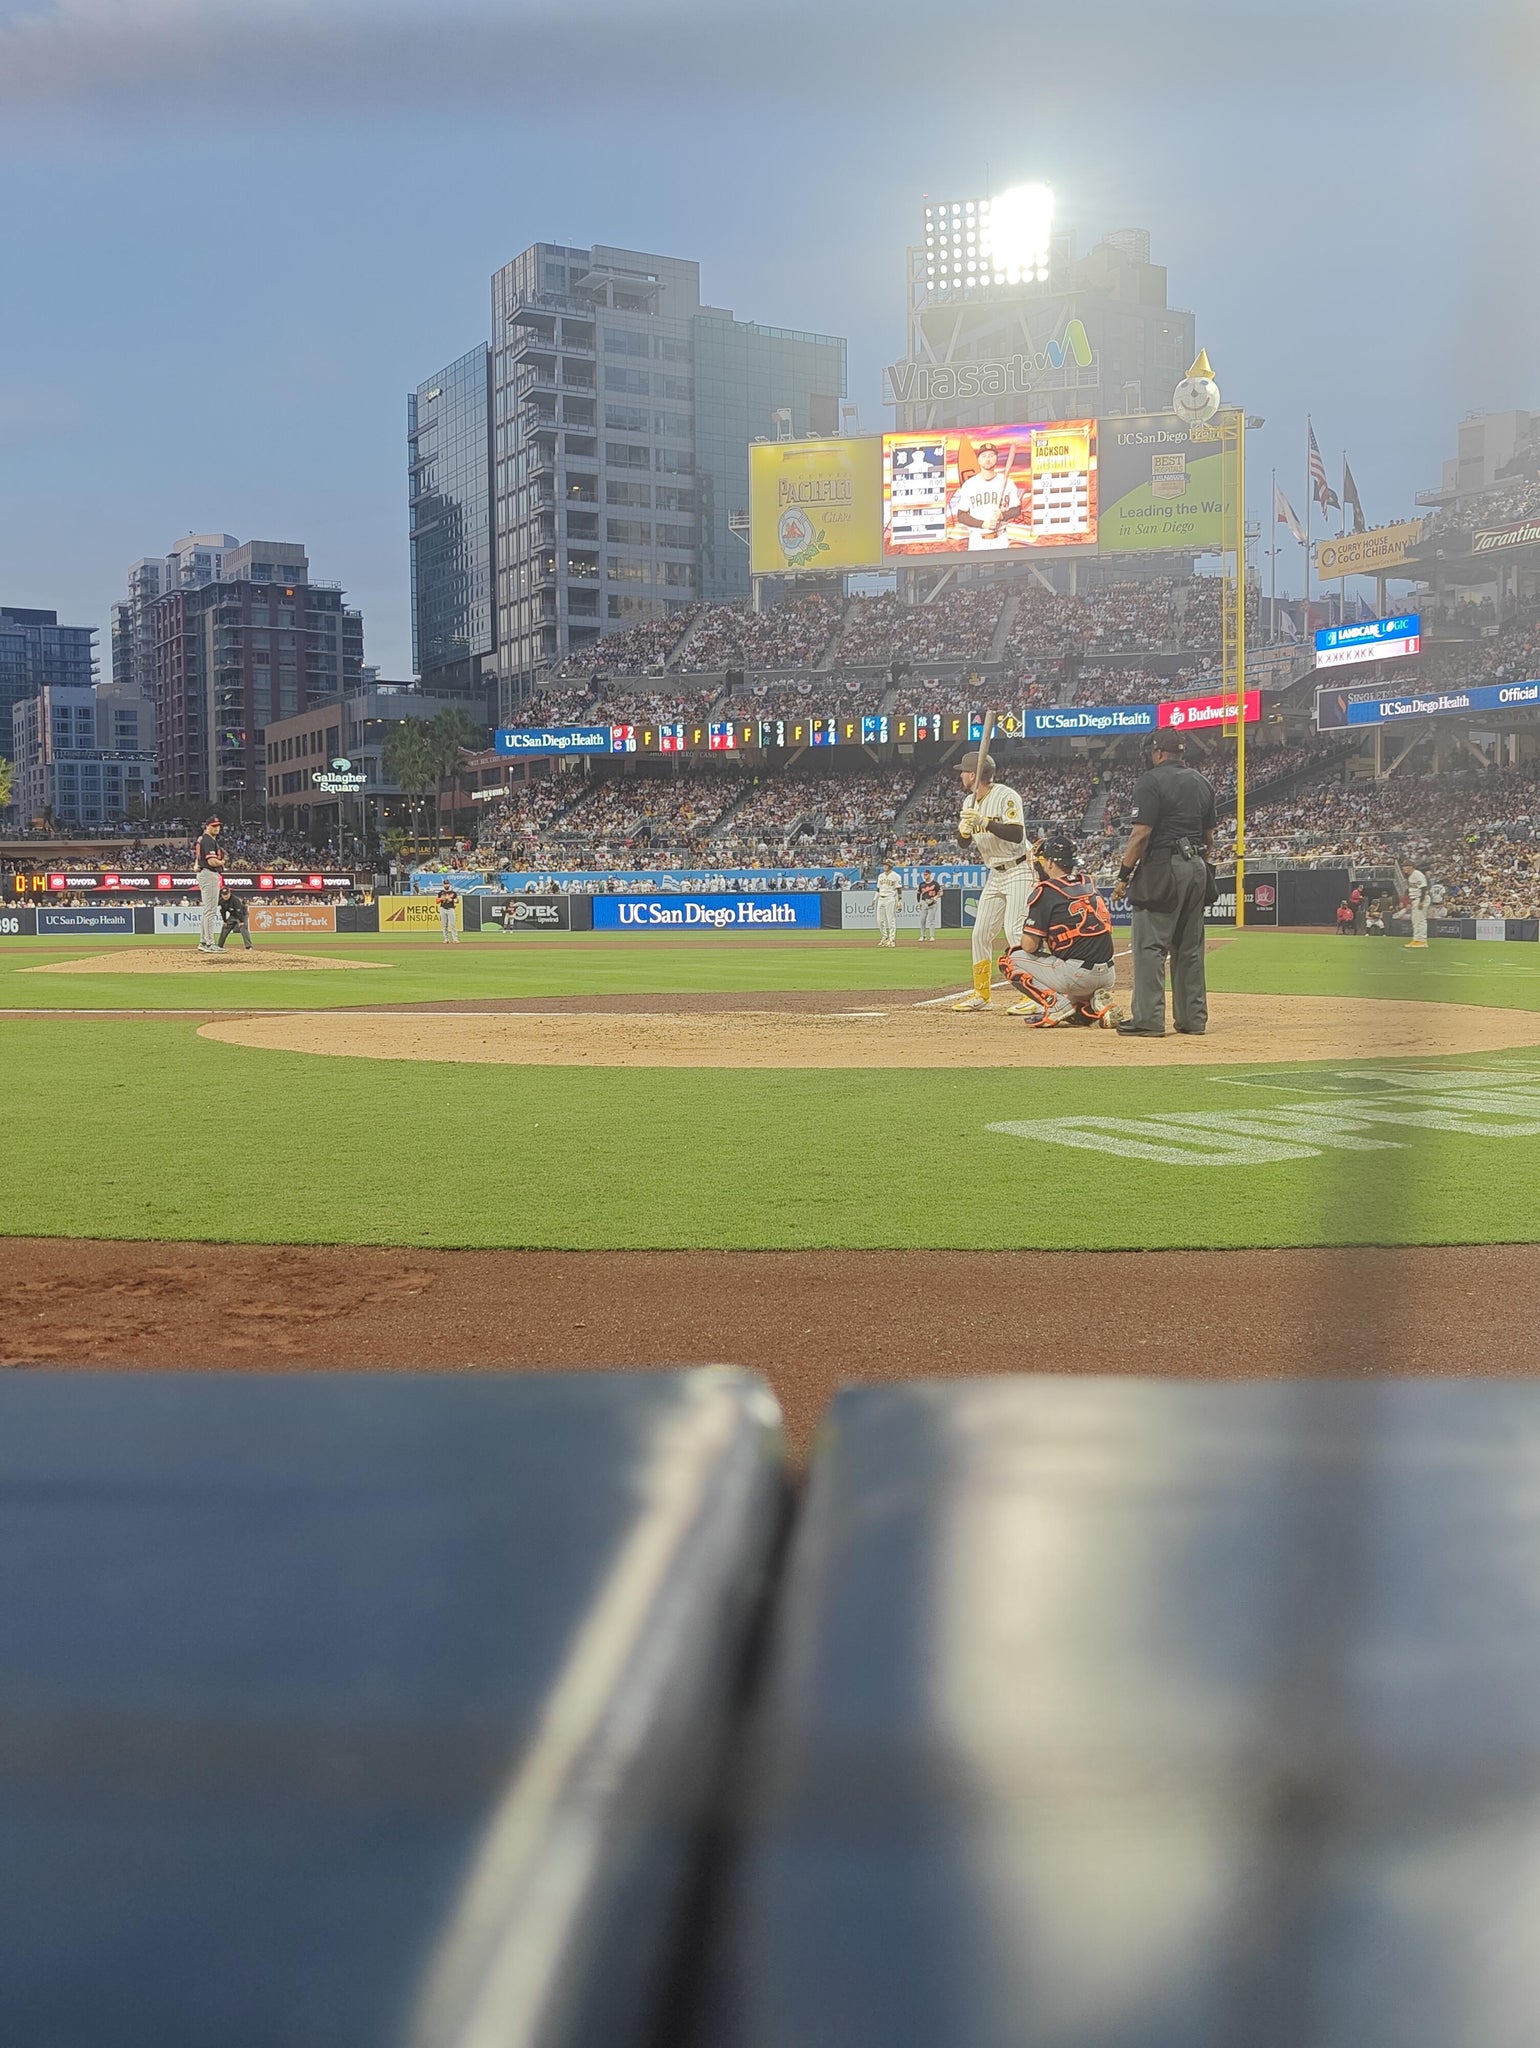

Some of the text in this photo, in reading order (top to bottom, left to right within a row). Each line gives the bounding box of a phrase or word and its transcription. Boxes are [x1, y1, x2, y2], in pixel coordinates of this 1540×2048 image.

[887, 353, 1031, 402] Viasat
[1117, 433, 1135, 446] UC
[1136, 432, 1156, 444] San
[1157, 430, 1188, 444] Diego
[1036, 446, 1069, 457] JACKSON
[1154, 456, 1184, 466] BEST
[970, 491, 1010, 510] PADRS
[1120, 505, 1173, 518] Leading
[1176, 503, 1198, 514] the
[1120, 521, 1194, 536] in San Diego
[1338, 536, 1388, 554] CURRY HOUSE
[1338, 552, 1360, 564] CoCo
[1499, 685, 1538, 703] Official
[1380, 695, 1470, 716] UC San Diego Health
[776, 720, 784, 734] 3
[814, 718, 835, 732] P 2
[880, 716, 888, 730] 2
[933, 714, 940, 728] 3
[952, 720, 959, 734] F
[1035, 712, 1150, 729] UC San Diego Health
[627, 726, 634, 739] 2
[676, 724, 683, 737] 5
[712, 722, 734, 736] T 5
[744, 728, 751, 741] F
[795, 726, 802, 740] F
[846, 724, 854, 738] F
[899, 722, 906, 736] F
[933, 727, 940, 741] 1
[505, 732, 604, 748] UC San Diego Health
[644, 731, 651, 745] F
[676, 737, 684, 750] 6
[694, 729, 701, 744] F
[726, 735, 734, 749] 4
[776, 733, 785, 747] 4
[828, 731, 836, 745] 4
[880, 730, 888, 743] 6
[613, 738, 637, 752] C 10
[312, 772, 368, 784] Gallagher
[320, 782, 360, 794] Square
[618, 902, 797, 927] UC San Diego Health
[845, 901, 875, 914] blue
[1212, 906, 1227, 917] ON
[0, 917, 19, 933] 96
[46, 915, 126, 927] UC San Diego Health
[275, 917, 328, 926] Safari Park
